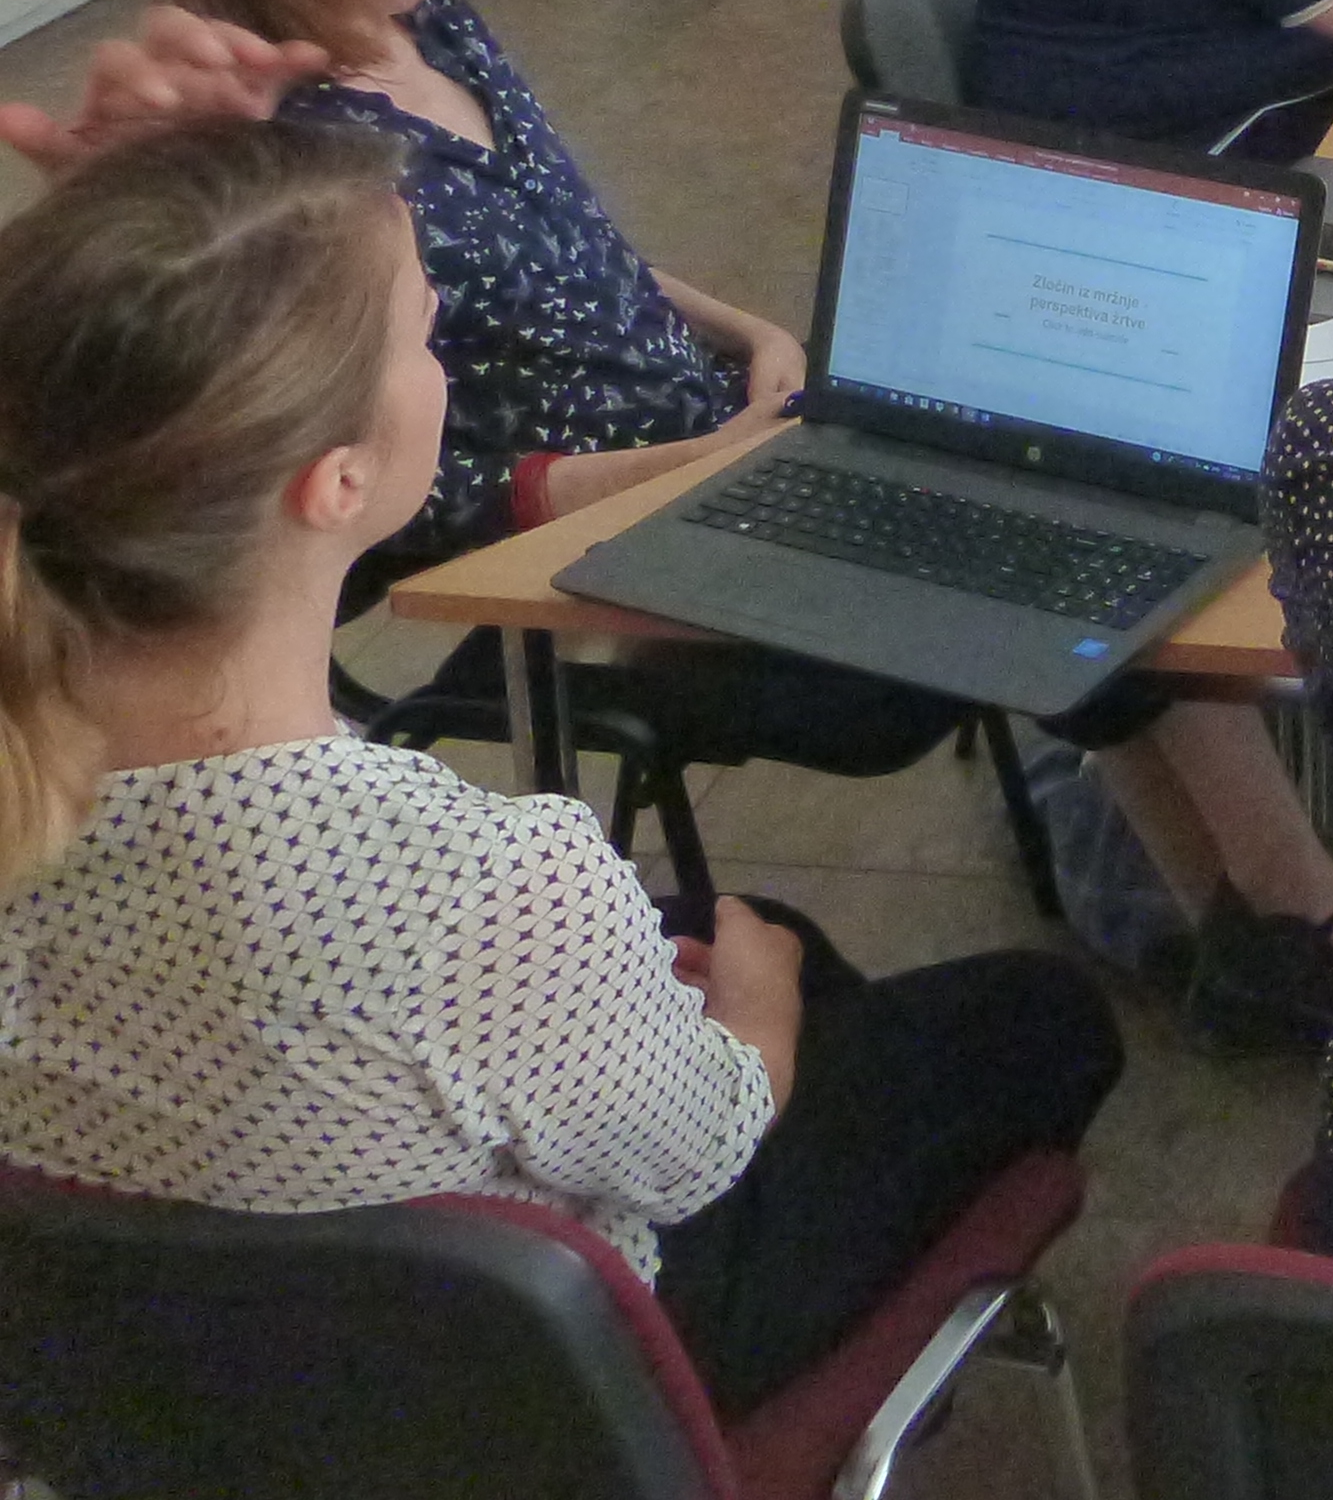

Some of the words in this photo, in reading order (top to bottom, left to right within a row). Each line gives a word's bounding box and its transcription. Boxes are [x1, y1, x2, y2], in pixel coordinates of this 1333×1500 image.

[1032, 274, 1075, 296] Zločin
[1078, 284, 1091, 299] iz
[1094, 289, 1140, 311] mržnje
[1029, 296, 1109, 324] perspektiva
